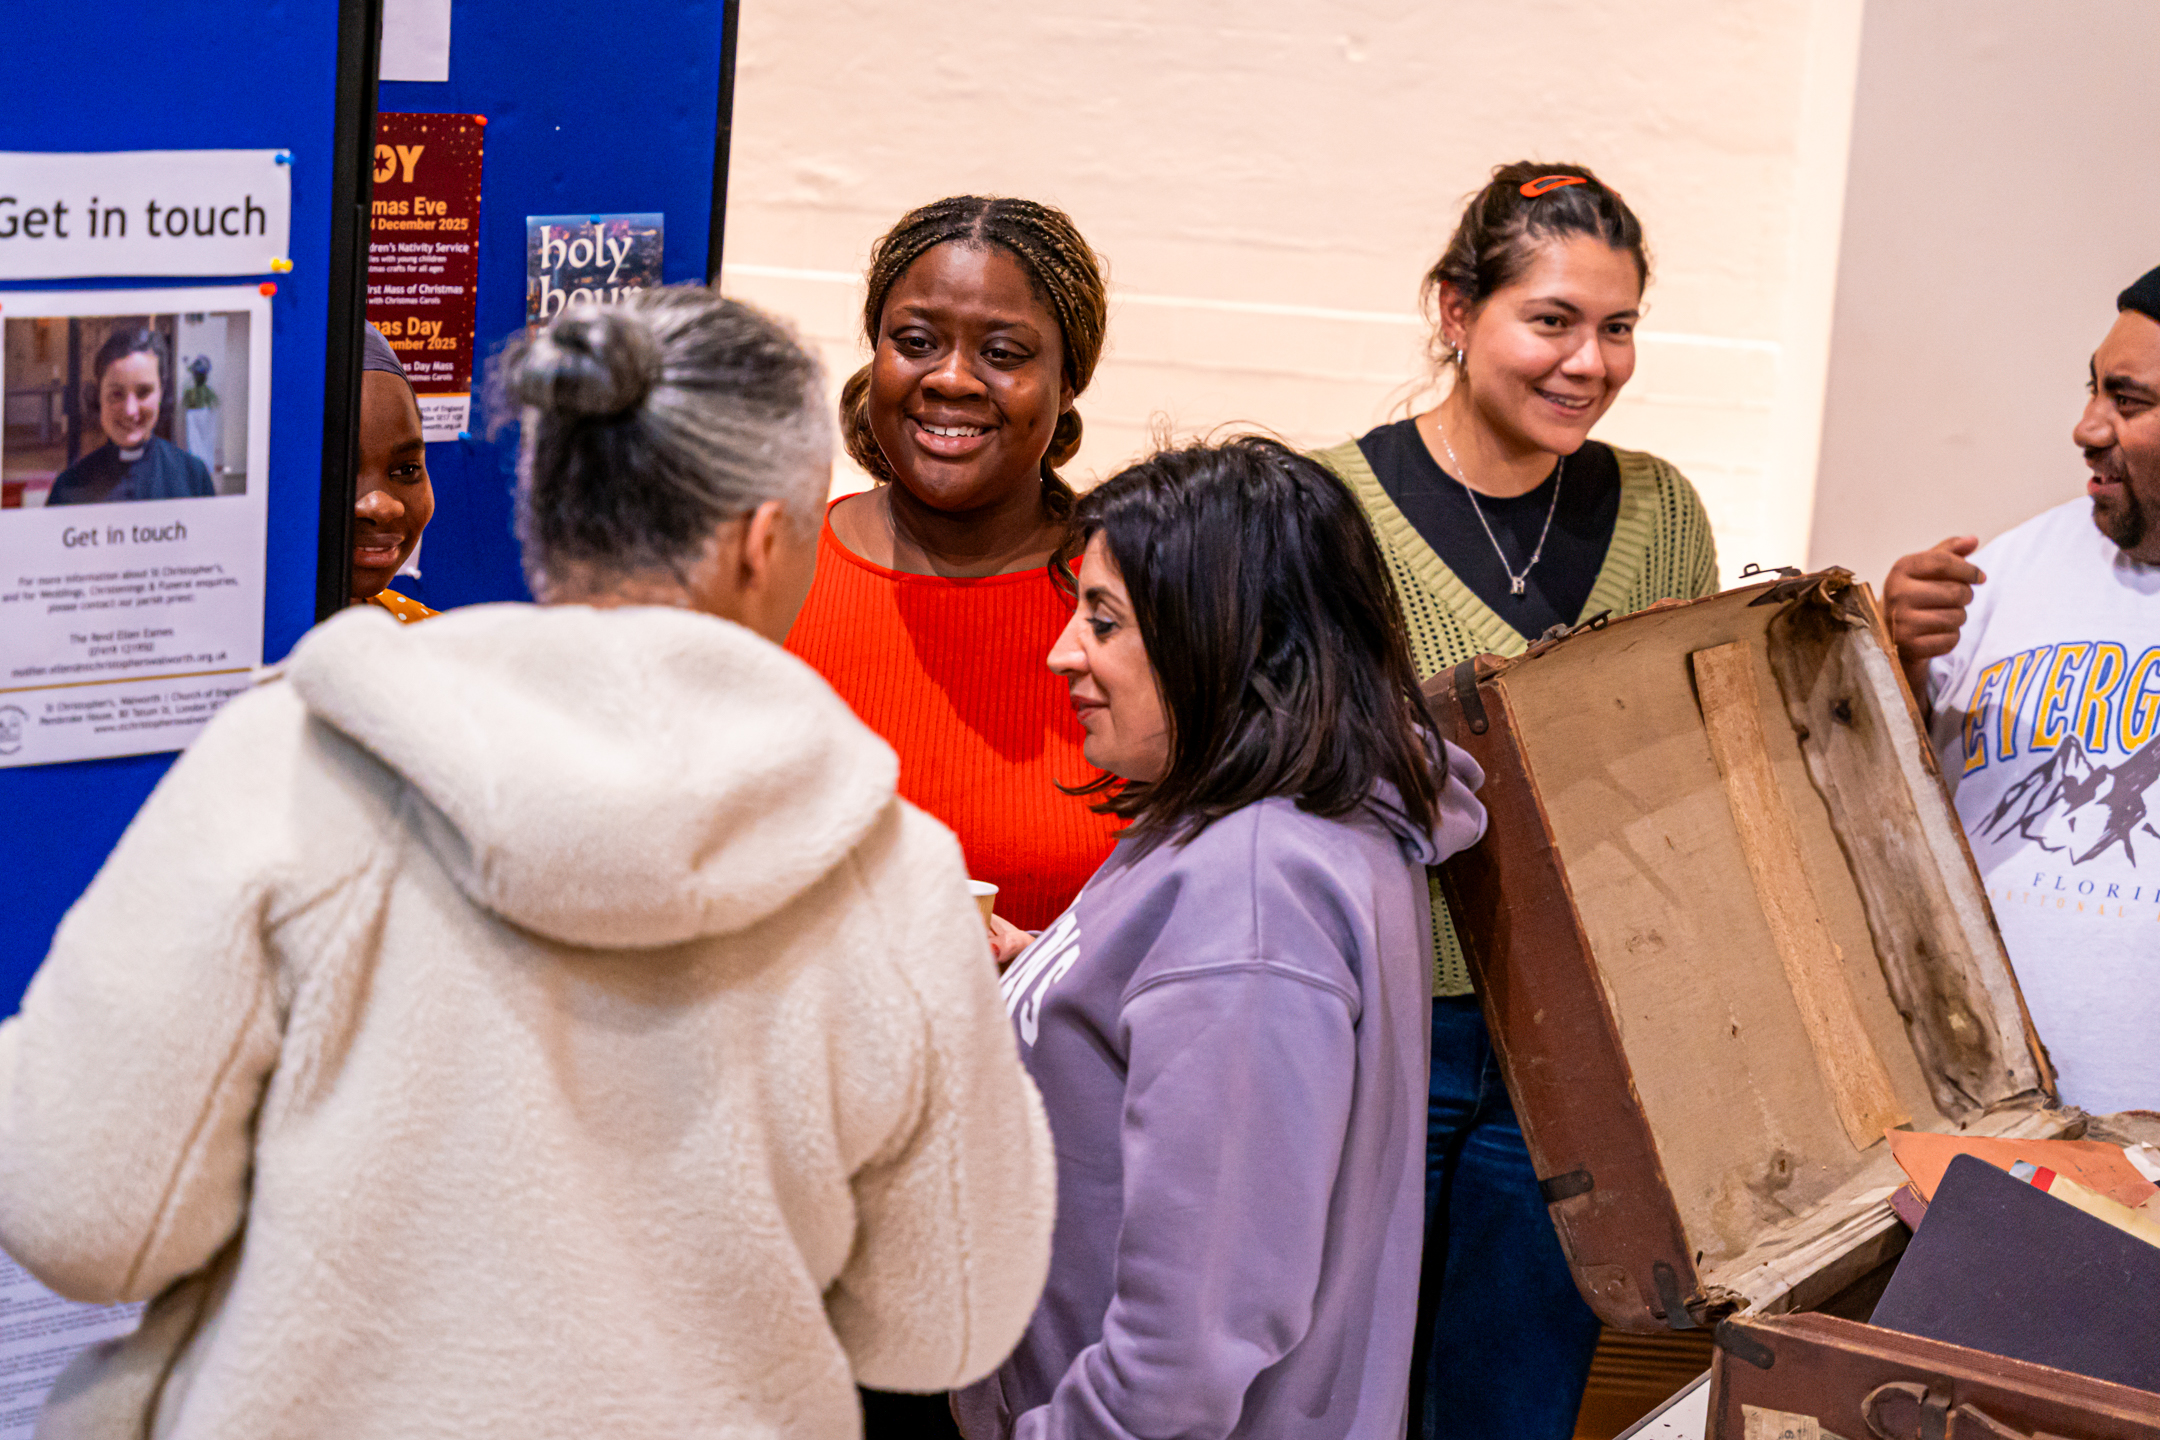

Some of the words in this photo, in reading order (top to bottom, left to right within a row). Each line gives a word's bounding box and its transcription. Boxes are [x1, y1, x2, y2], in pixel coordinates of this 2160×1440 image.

[373, 144, 425, 183] OY
[414, 196, 448, 216] Eve
[0, 197, 68, 238] Get
[88, 197, 126, 238] in
[147, 195, 266, 237] touch
[378, 217, 437, 231] December
[438, 217, 469, 231] 2025
[369, 242, 397, 253] dren's
[398, 242, 434, 255] Nativity
[435, 242, 470, 253] Service
[540, 223, 633, 284] holy
[419, 254, 447, 263] children
[407, 264, 418, 272] for
[367, 285, 382, 295] irst
[383, 285, 405, 295] Mass
[406, 284, 418, 295] of
[418, 284, 464, 295] Christmas
[384, 296, 418, 305] Christmas
[407, 316, 443, 341] Day
[389, 337, 425, 350] ember
[427, 337, 457, 350] 2025
[413, 360, 431, 373] Day
[432, 361, 454, 371] Mass
[406, 374, 431, 382] ristmas
[62, 526, 98, 548] Get
[106, 526, 125, 544] in
[131, 520, 188, 543] touch
